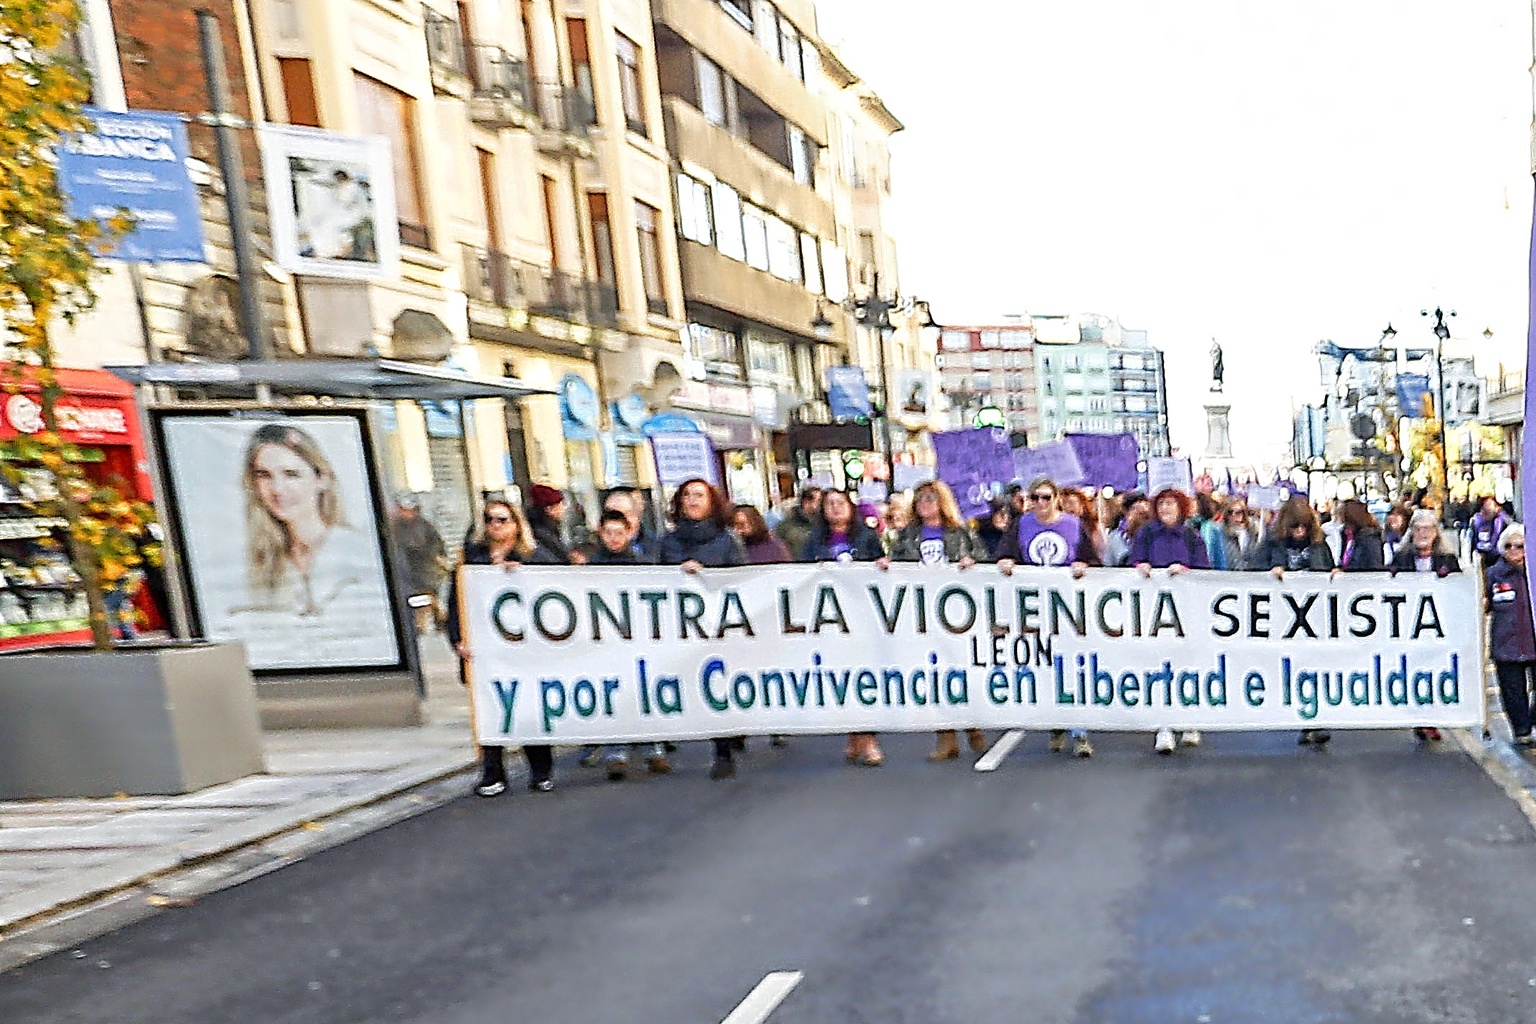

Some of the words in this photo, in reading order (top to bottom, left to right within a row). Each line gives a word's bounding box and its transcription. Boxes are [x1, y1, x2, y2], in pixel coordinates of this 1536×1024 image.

[493, 590, 756, 641] CONTRA
[780, 587, 850, 634] LA
[868, 583, 1184, 637] VIOLENCIA
[1212, 592, 1445, 639] SEXISTA
[493, 680, 519, 732] y
[541, 676, 619, 731] por
[638, 659, 683, 715] la
[702, 652, 970, 711] Convivencia
[990, 667, 1037, 704] en
[1053, 653, 1227, 707] Libertad
[1246, 671, 1267, 706] e
[1282, 652, 1461, 719] Igualdad
